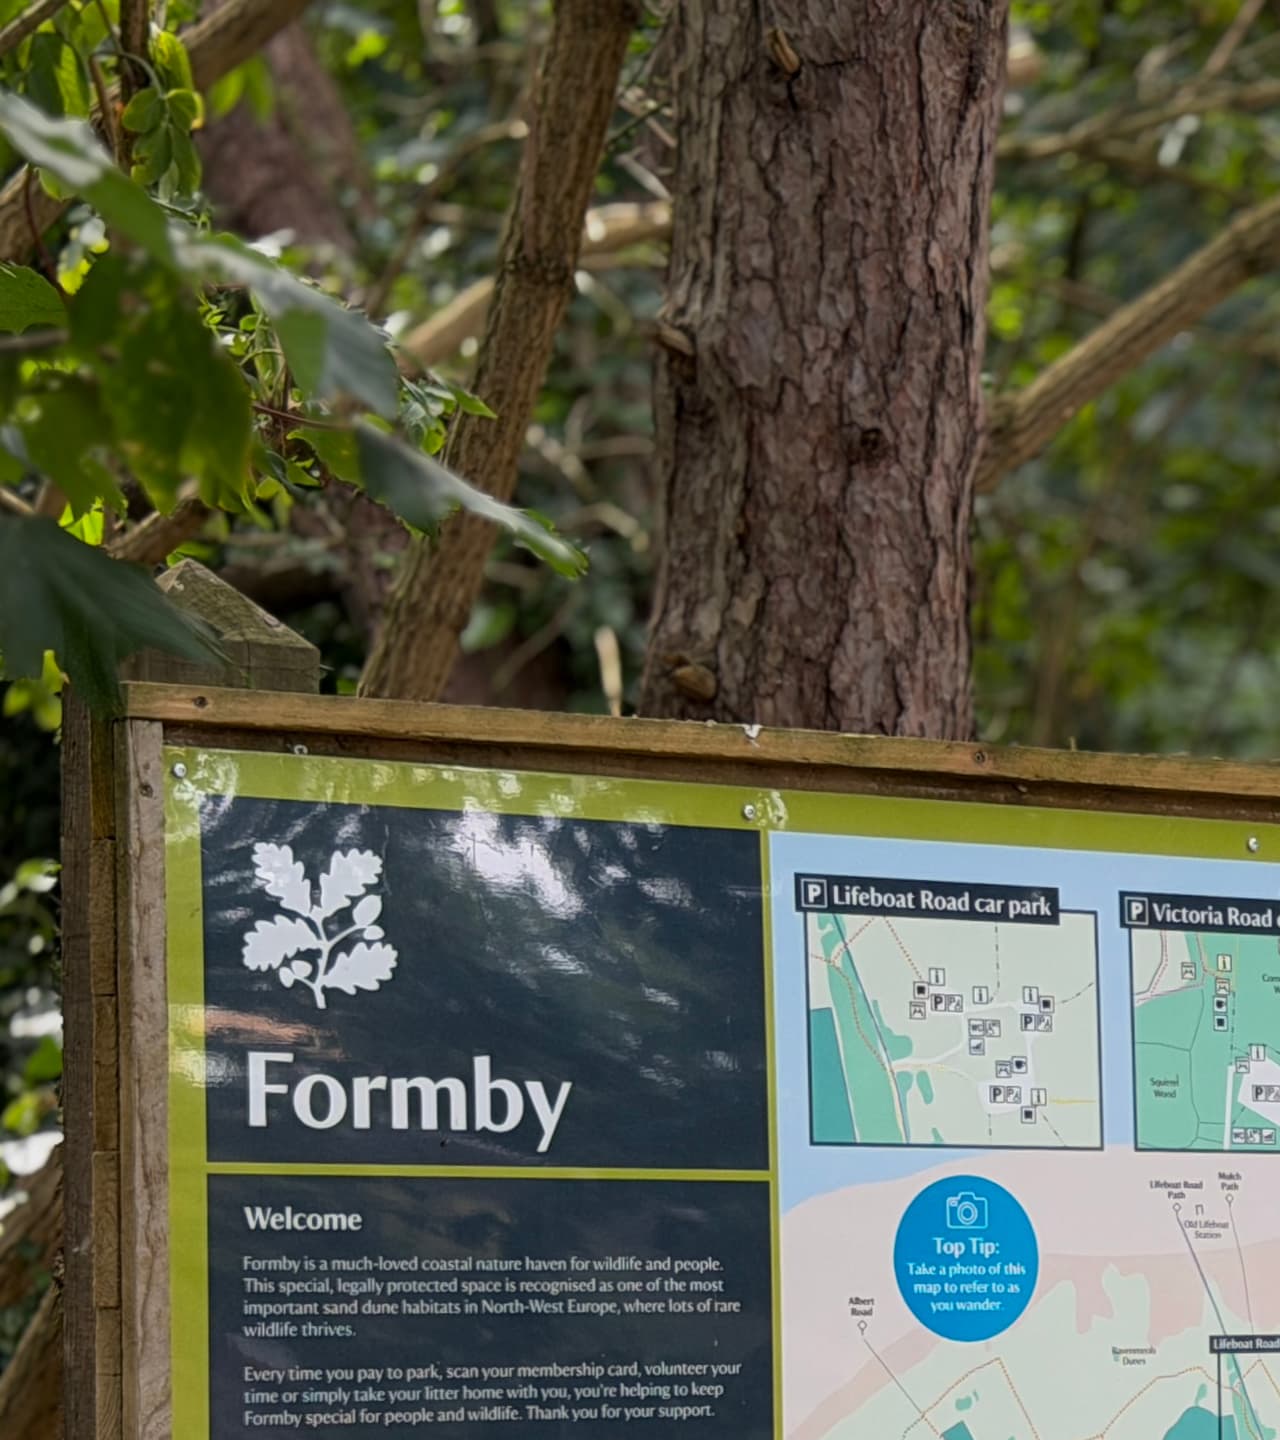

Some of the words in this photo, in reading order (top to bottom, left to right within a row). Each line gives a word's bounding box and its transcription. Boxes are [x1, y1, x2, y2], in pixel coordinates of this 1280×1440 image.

[807, 884, 822, 903] P
[833, 885, 916, 909] Lifeboat
[920, 890, 970, 912] Road
[974, 898, 1005, 913] car
[1008, 893, 1052, 918] park
[1131, 901, 1144, 921] P
[1152, 903, 1224, 925] Victoria
[1227, 907, 1273, 928] Road
[246, 1051, 573, 1153] Formby
[243, 1206, 363, 1230] Welcome
[933, 1237, 966, 1259] Top
[968, 1237, 1000, 1259] Tip:
[243, 1255, 301, 1273] Formby
[303, 1255, 316, 1271] is
[318, 1259, 328, 1271] a
[331, 1256, 419, 1271] much-loved
[421, 1256, 473, 1271] coastal
[475, 1259, 523, 1271] nature
[525, 1256, 567, 1271] haven
[570, 1255, 591, 1271] for
[592, 1256, 643, 1271] wildlife
[645, 1256, 671, 1271] and
[674, 1256, 724, 1274] people.
[907, 1262, 937, 1275] Take
[939, 1265, 947, 1276] a
[948, 1262, 986, 1278] photo
[987, 1261, 1002, 1275] of
[1003, 1262, 1027, 1275] this
[913, 1283, 942, 1296] map
[943, 1282, 958, 1294] to
[959, 1280, 989, 1293] refer
[991, 1282, 1006, 1293] to
[1007, 1283, 1021, 1293] as
[930, 1301, 954, 1314] you
[1213, 1338, 1253, 1350] Lifeboat
[1255, 1337, 1280, 1349] Road
